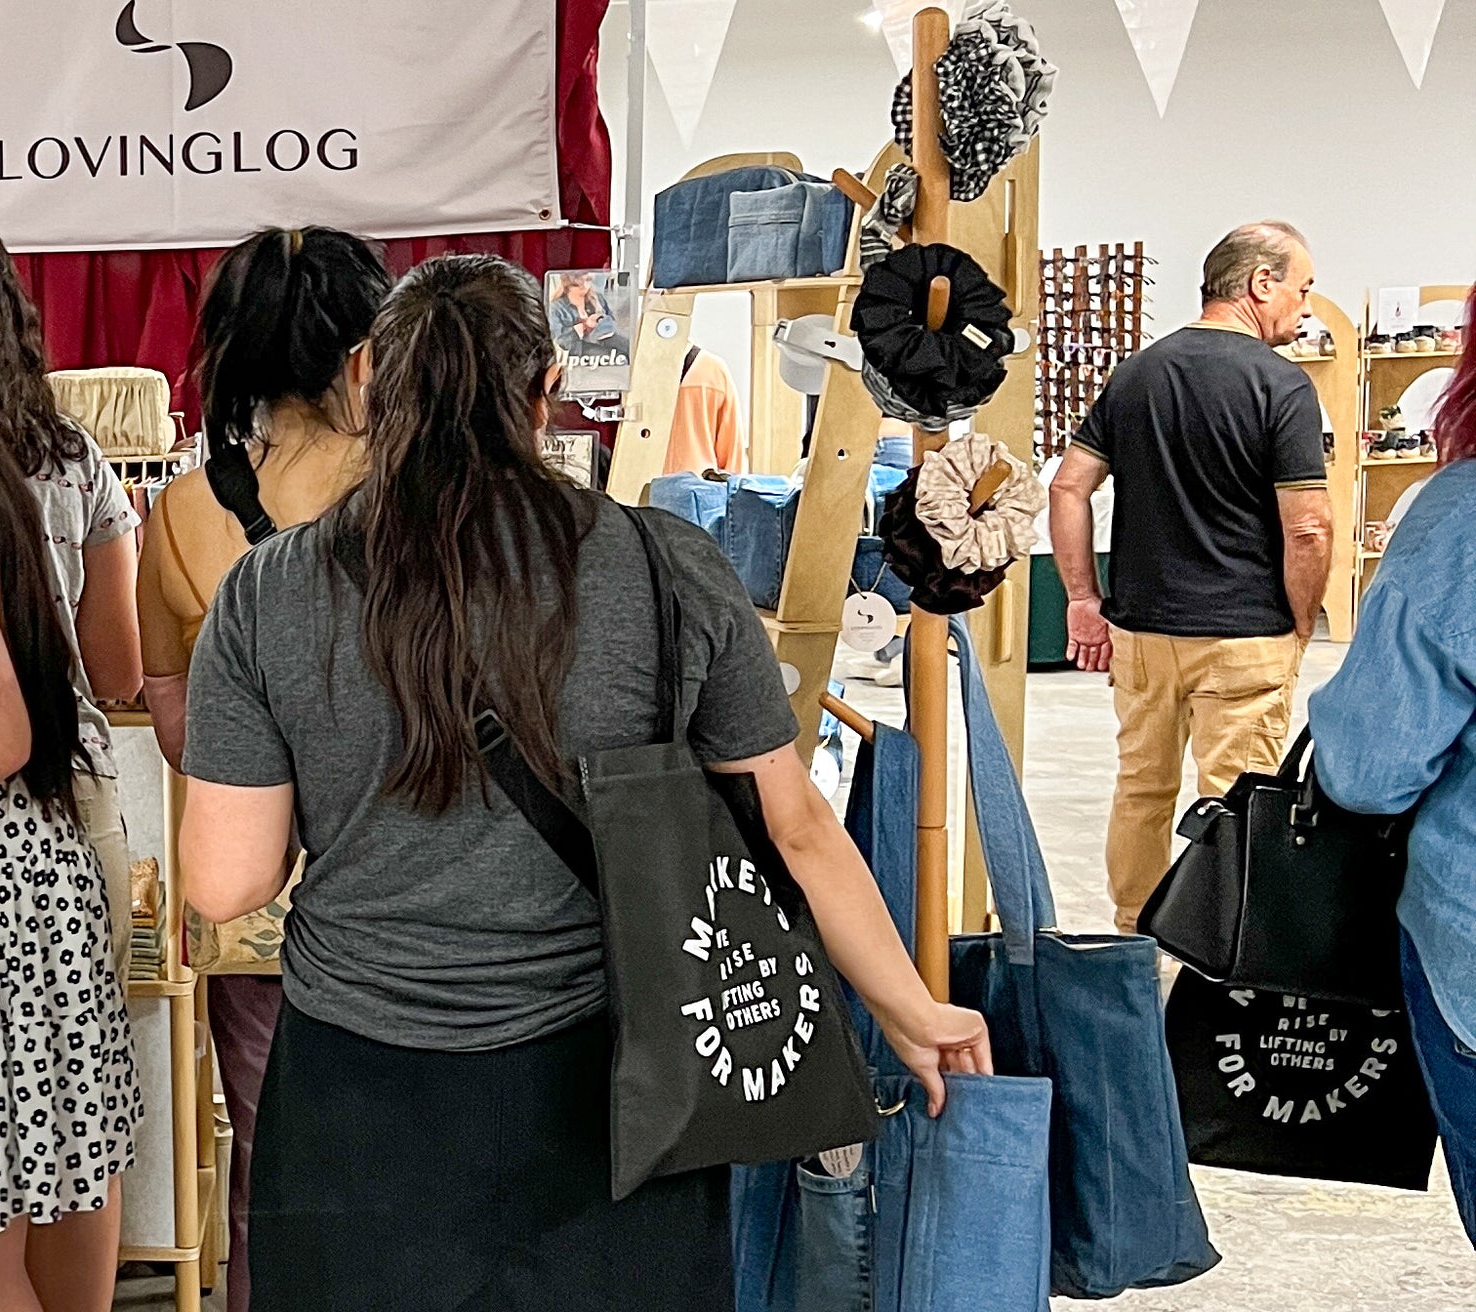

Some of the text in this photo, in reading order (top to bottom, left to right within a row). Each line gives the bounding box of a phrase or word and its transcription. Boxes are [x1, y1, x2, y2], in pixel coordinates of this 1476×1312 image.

[758, 957, 777, 978] BY
[721, 980, 765, 1012] FTING
[726, 998, 781, 1031] OTHERS
[742, 951, 821, 1102] MAKERS
[1277, 1013, 1330, 1031] RISE
[680, 997, 733, 1087] FOR
[1259, 1034, 1327, 1054] LIFTING
[1329, 1028, 1348, 1042] BY
[1215, 1033, 1256, 1098] FOR
[1270, 1052, 1335, 1071] OTHERS
[1262, 1037, 1398, 1125] MAKERS
